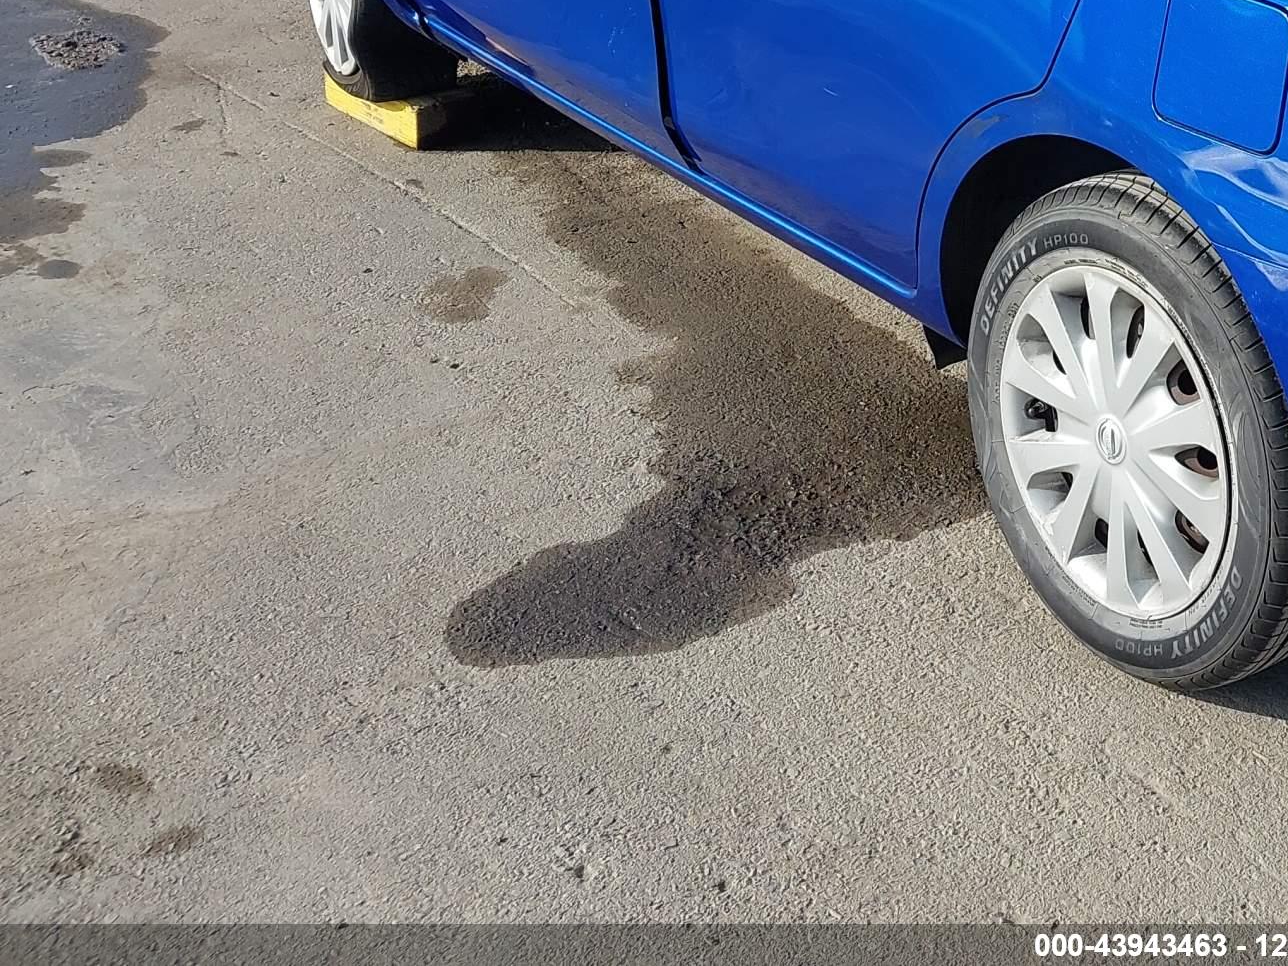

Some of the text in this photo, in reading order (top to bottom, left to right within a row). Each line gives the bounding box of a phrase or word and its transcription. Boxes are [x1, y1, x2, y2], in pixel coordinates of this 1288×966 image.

[980, 236, 1038, 337] DEFINITY
[1043, 232, 1090, 249] HP100
[1114, 639, 1163, 656] HP100
[1171, 565, 1243, 659] DEFINITY
